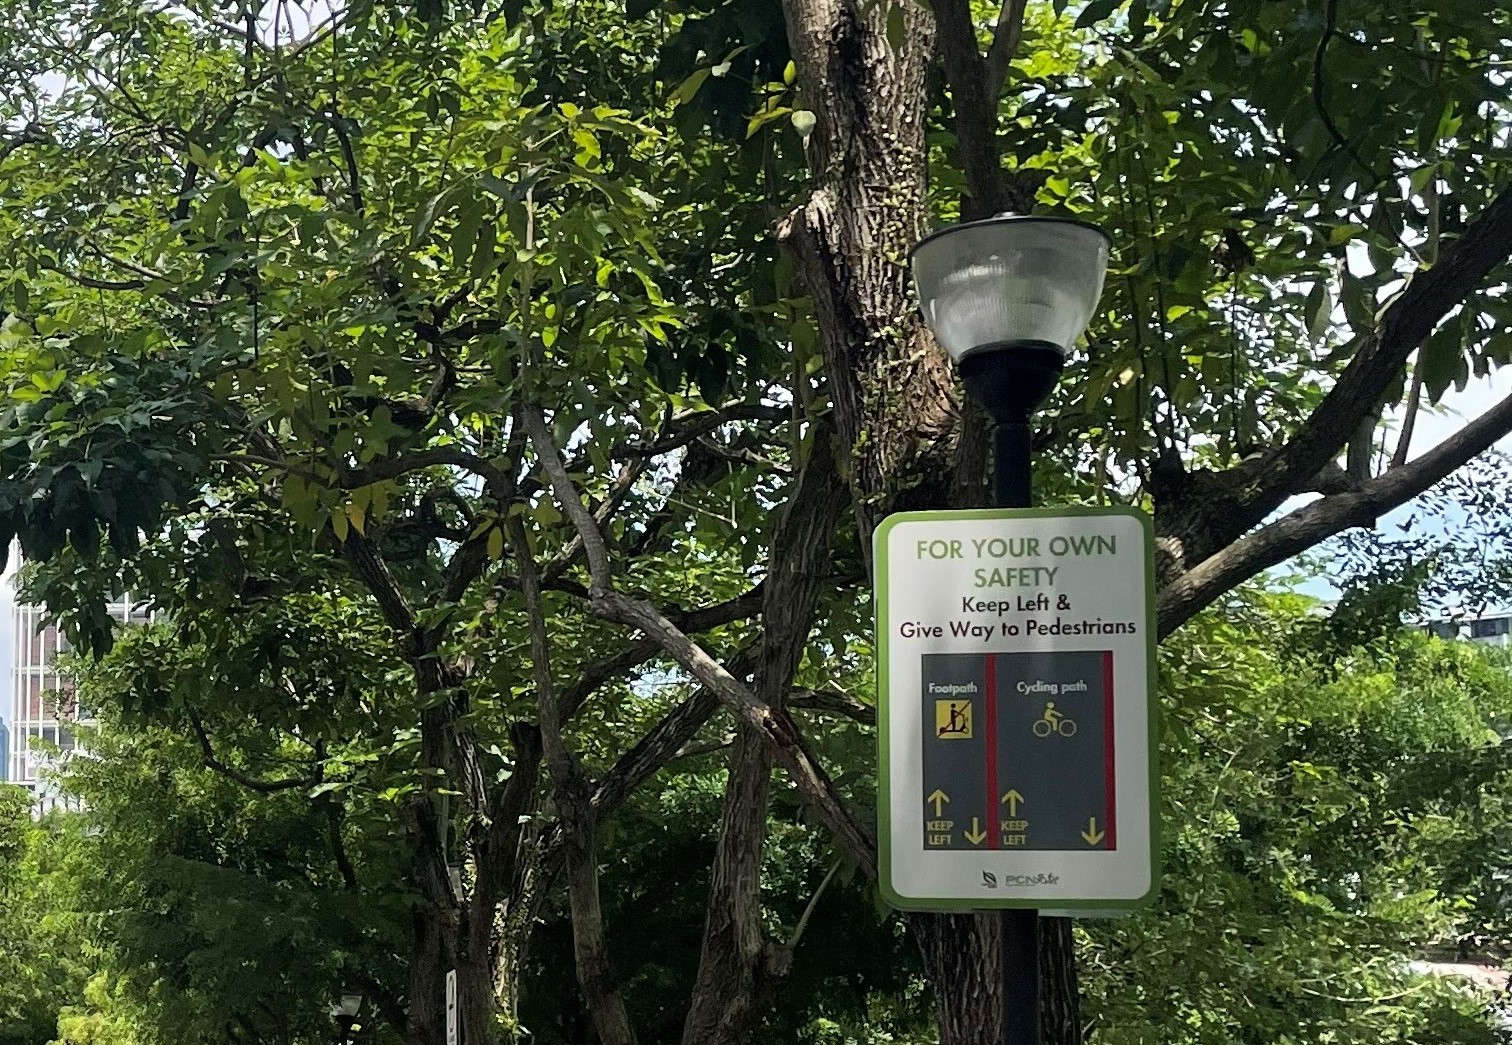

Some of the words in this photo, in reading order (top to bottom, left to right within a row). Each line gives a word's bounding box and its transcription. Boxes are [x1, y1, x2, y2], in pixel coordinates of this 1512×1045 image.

[916, 540, 963, 560] FOR
[971, 537, 1041, 558] YOUR
[1049, 535, 1117, 556] OWN
[974, 566, 1059, 588] SAFETY
[962, 596, 1010, 616] Keep
[1017, 593, 1050, 612] Left
[1056, 594, 1071, 611] &
[900, 621, 943, 639] Give
[949, 620, 995, 642] Way
[1002, 621, 1019, 638] to
[1026, 617, 1137, 637] Pedestrians
[928, 680, 978, 696] Footpath
[1016, 680, 1059, 695] Cycling
[1061, 679, 1088, 695] path
[926, 820, 955, 831] KEEP
[1000, 820, 1029, 831] KEEP
[929, 834, 952, 845] LEFT
[1003, 834, 1027, 846] LEFT
